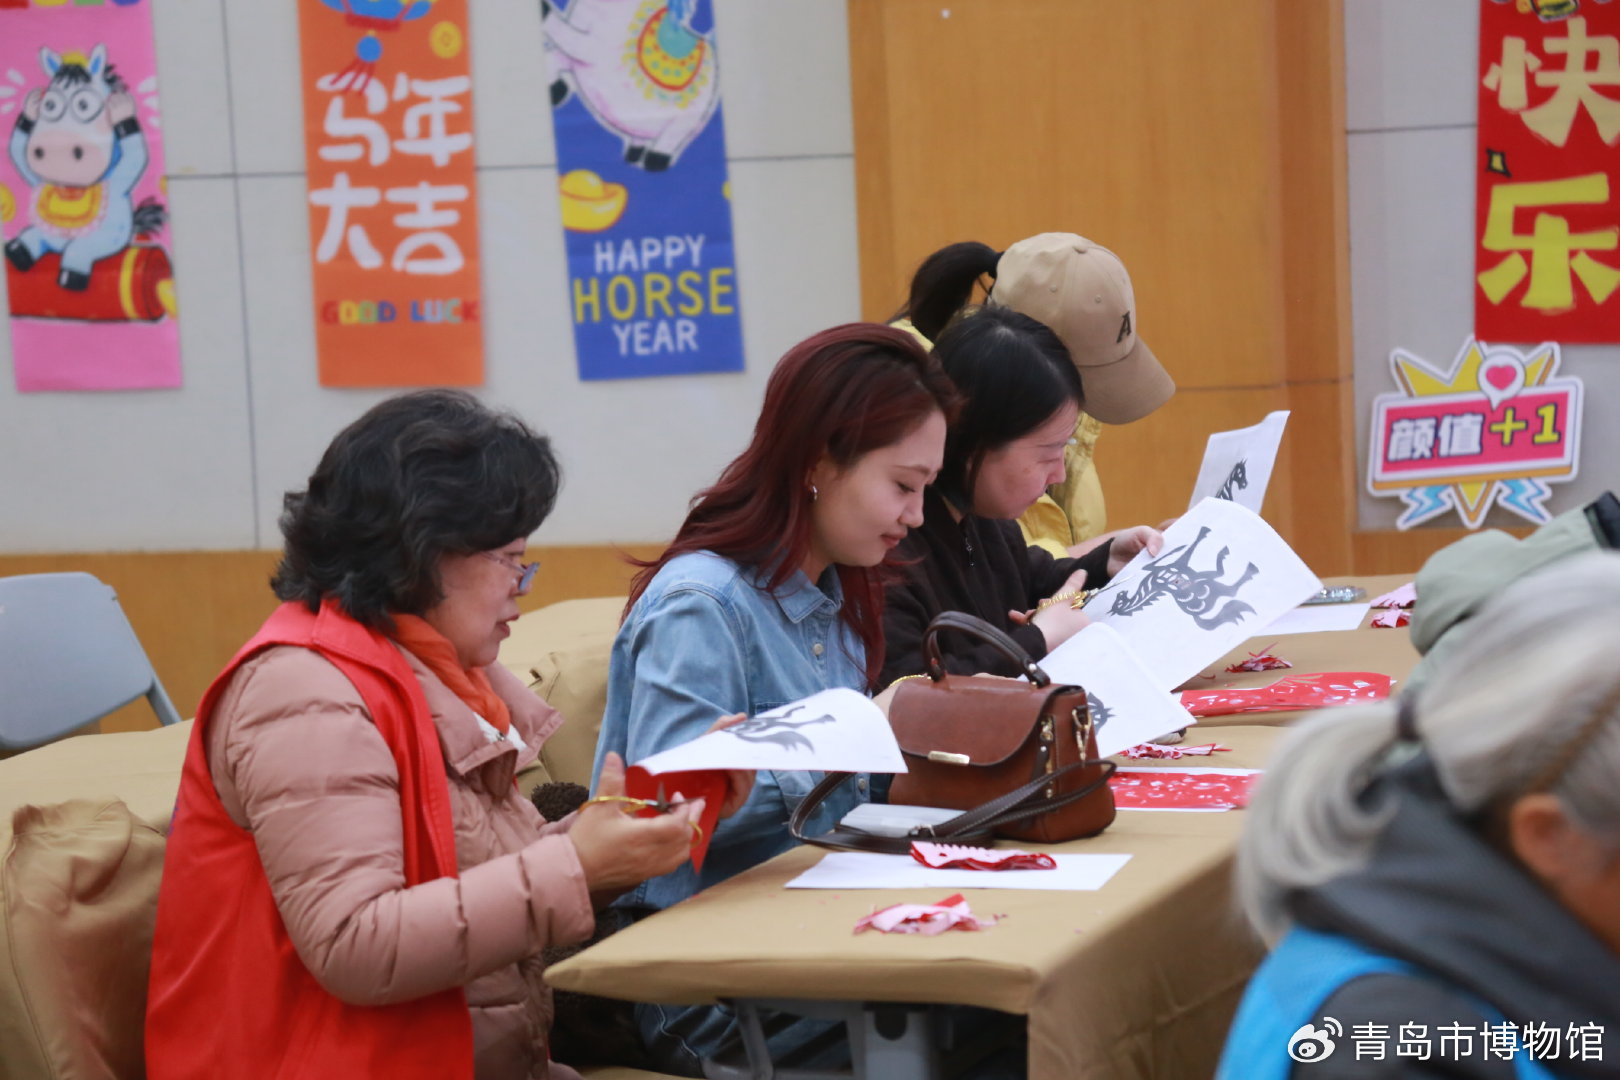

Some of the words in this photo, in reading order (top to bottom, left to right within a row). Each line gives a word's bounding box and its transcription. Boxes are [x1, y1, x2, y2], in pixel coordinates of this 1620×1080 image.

[315, 73, 473, 167] 马年
[1477, 16, 1620, 312] 快乐
[309, 172, 469, 275] 大吉
[594, 234, 706, 274] HAPPY
[321, 300, 397, 325] GOOD
[410, 298, 478, 323] LUCK
[573, 267, 734, 323] HORSE
[612, 319, 700, 356] YEAR
[1116, 310, 1132, 344] A
